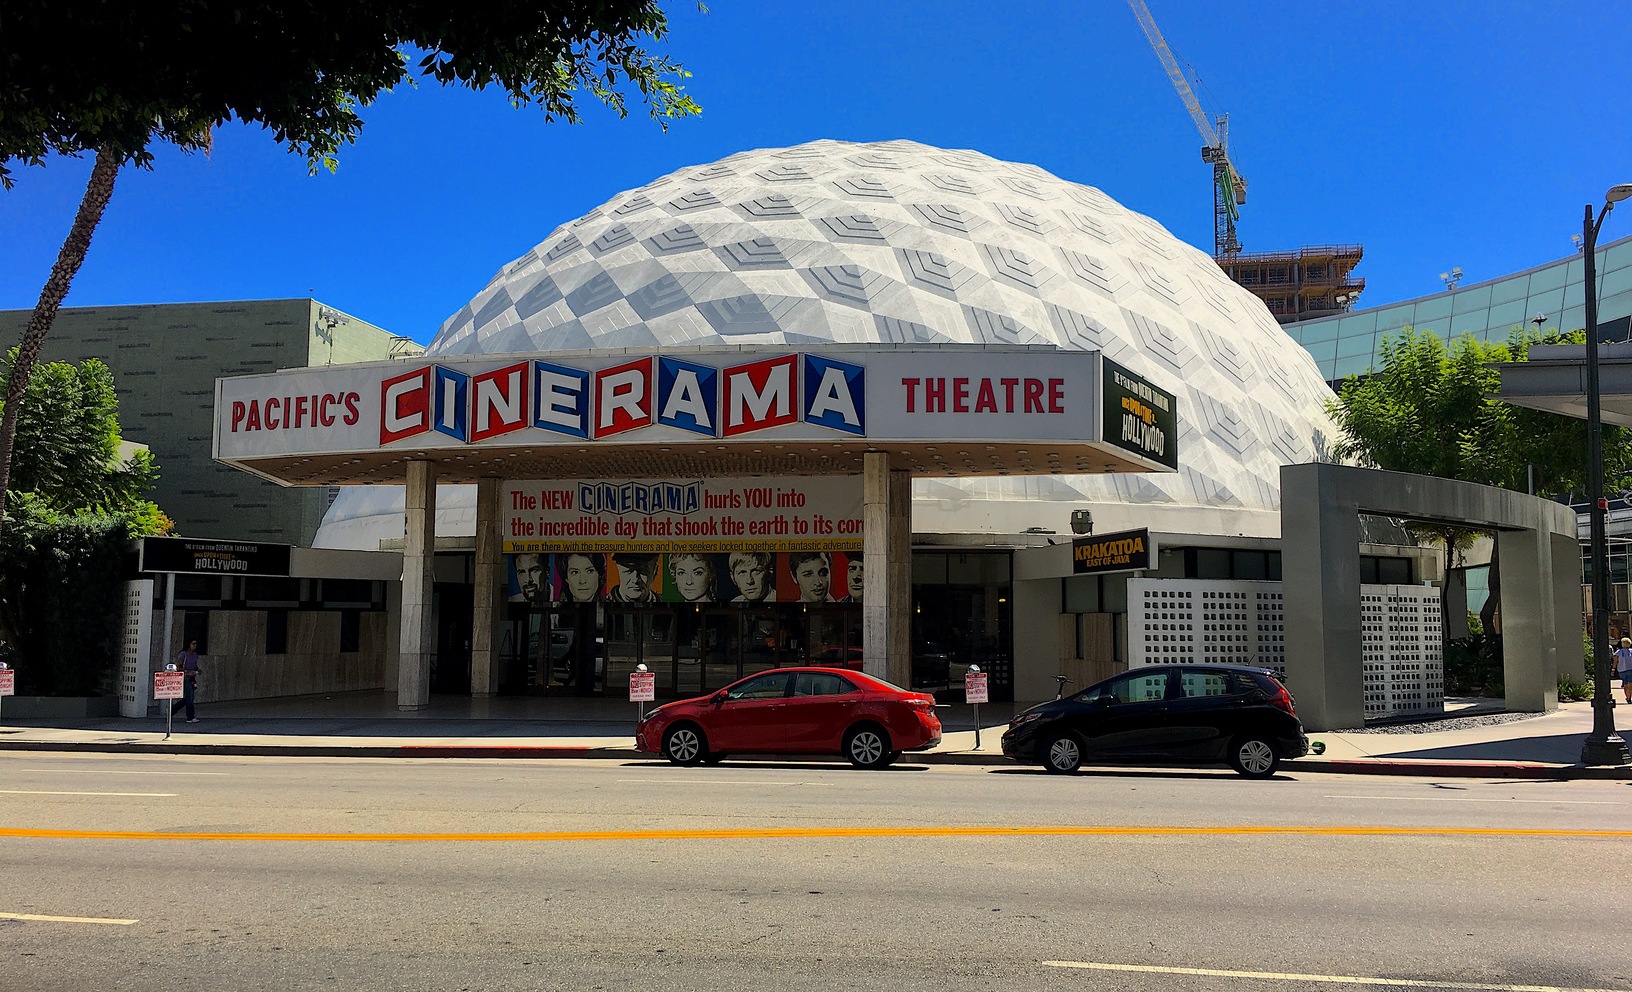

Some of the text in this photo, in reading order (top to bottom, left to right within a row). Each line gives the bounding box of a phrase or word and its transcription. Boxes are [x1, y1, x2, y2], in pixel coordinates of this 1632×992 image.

[231, 362, 1065, 433] PACIFIC'S CINERAMA THEATRE
[1122, 413, 1165, 456] HOLLYWOOD
[511, 484, 806, 512] The NEW CINERAMA hurls YOU into
[511, 514, 864, 540] the incredible day that shook the earth to its cor
[512, 542, 525, 552] You
[527, 544, 540, 552] are
[541, 542, 561, 552] there
[563, 541, 580, 551] with
[581, 542, 593, 551] the
[595, 543, 626, 551] treasure
[627, 542, 655, 551] hunters
[656, 542, 670, 551] and
[672, 542, 687, 551] love
[689, 542, 718, 551] seekers
[720, 541, 744, 551] locked
[745, 541, 777, 552] together
[779, 541, 786, 551] in
[788, 540, 821, 551] fantastic
[1075, 537, 1144, 561] KRAKATOA
[195, 558, 248, 571] HOLLYWOOD
[1086, 555, 1130, 567] EAST OF JAVA
[966, 681, 973, 689] NO
